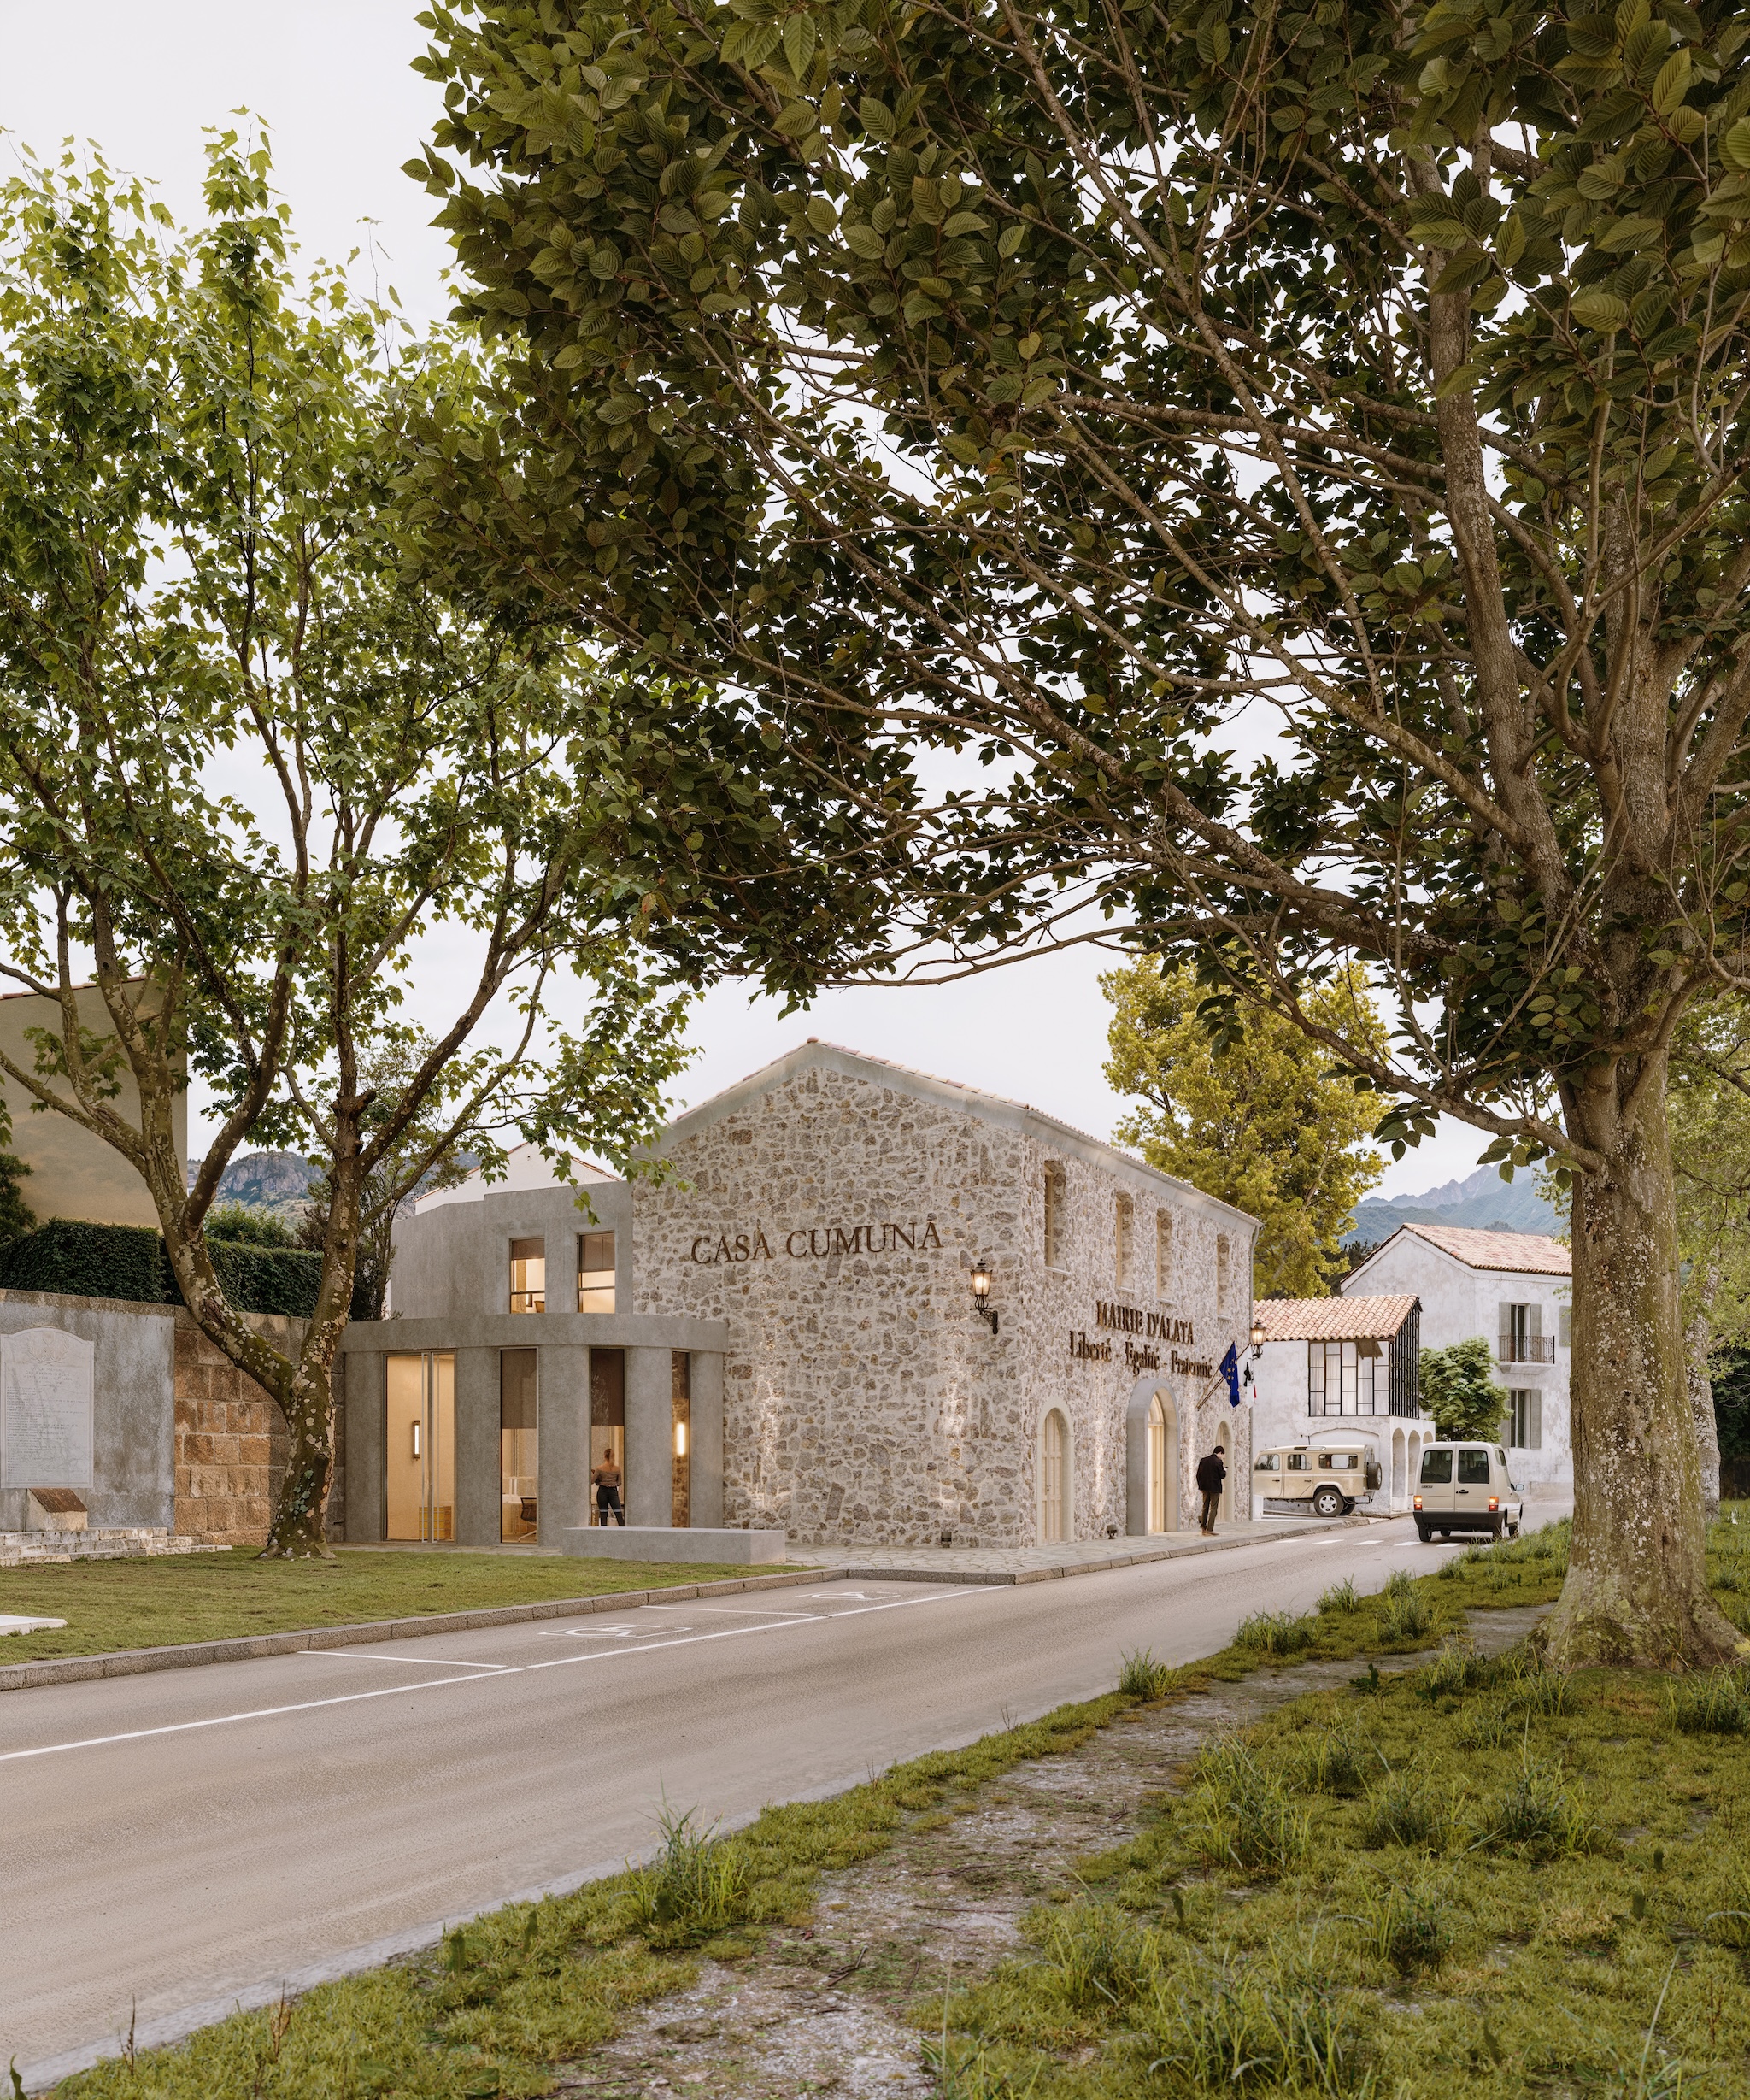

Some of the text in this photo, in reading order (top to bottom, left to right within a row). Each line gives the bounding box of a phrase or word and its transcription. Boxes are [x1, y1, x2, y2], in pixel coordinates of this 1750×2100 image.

[1096, 1301, 1194, 1344] MAIRIE D'ALATA
[1070, 1330, 1112, 1362] Liberté
